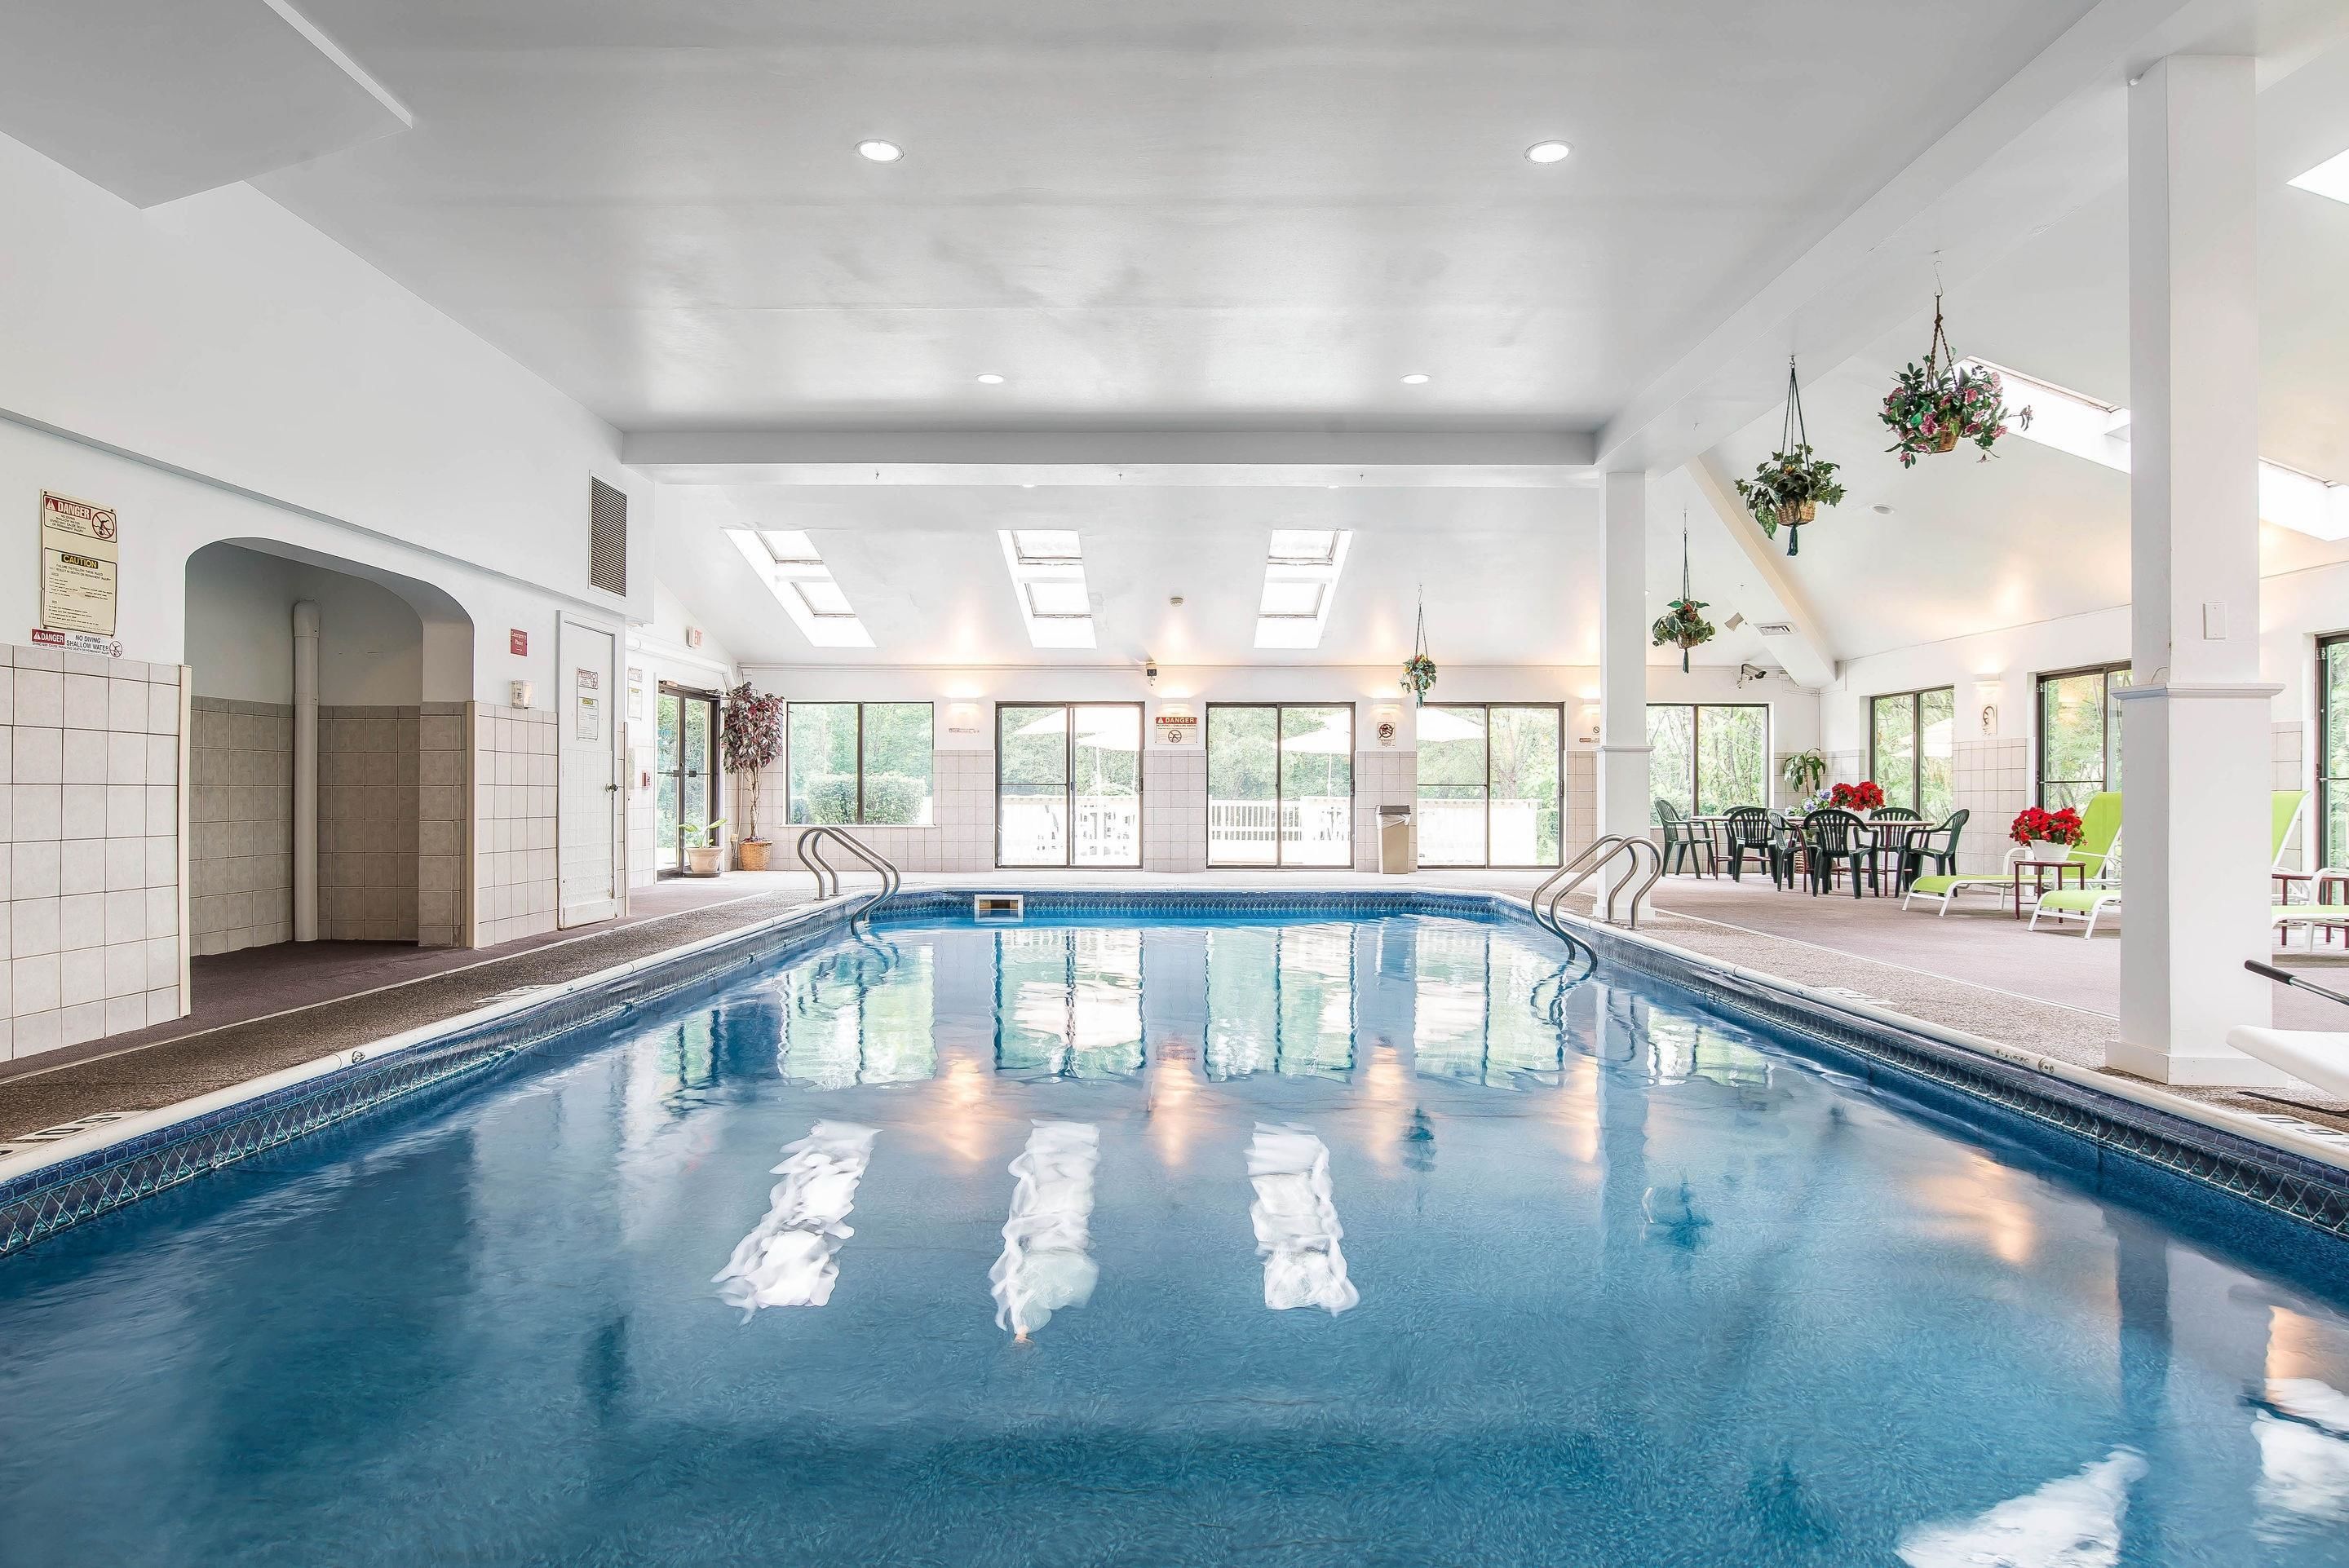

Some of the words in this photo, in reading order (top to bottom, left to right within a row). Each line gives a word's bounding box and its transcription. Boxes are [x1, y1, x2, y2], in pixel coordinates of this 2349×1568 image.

[57, 501, 91, 519] DANGER
[63, 555, 97, 568] CAUTION
[41, 633, 64, 643] DANGER
[84, 636, 101, 644] DIVING
[66, 640, 91, 649] SHALLOW
[92, 643, 109, 651] WATER
